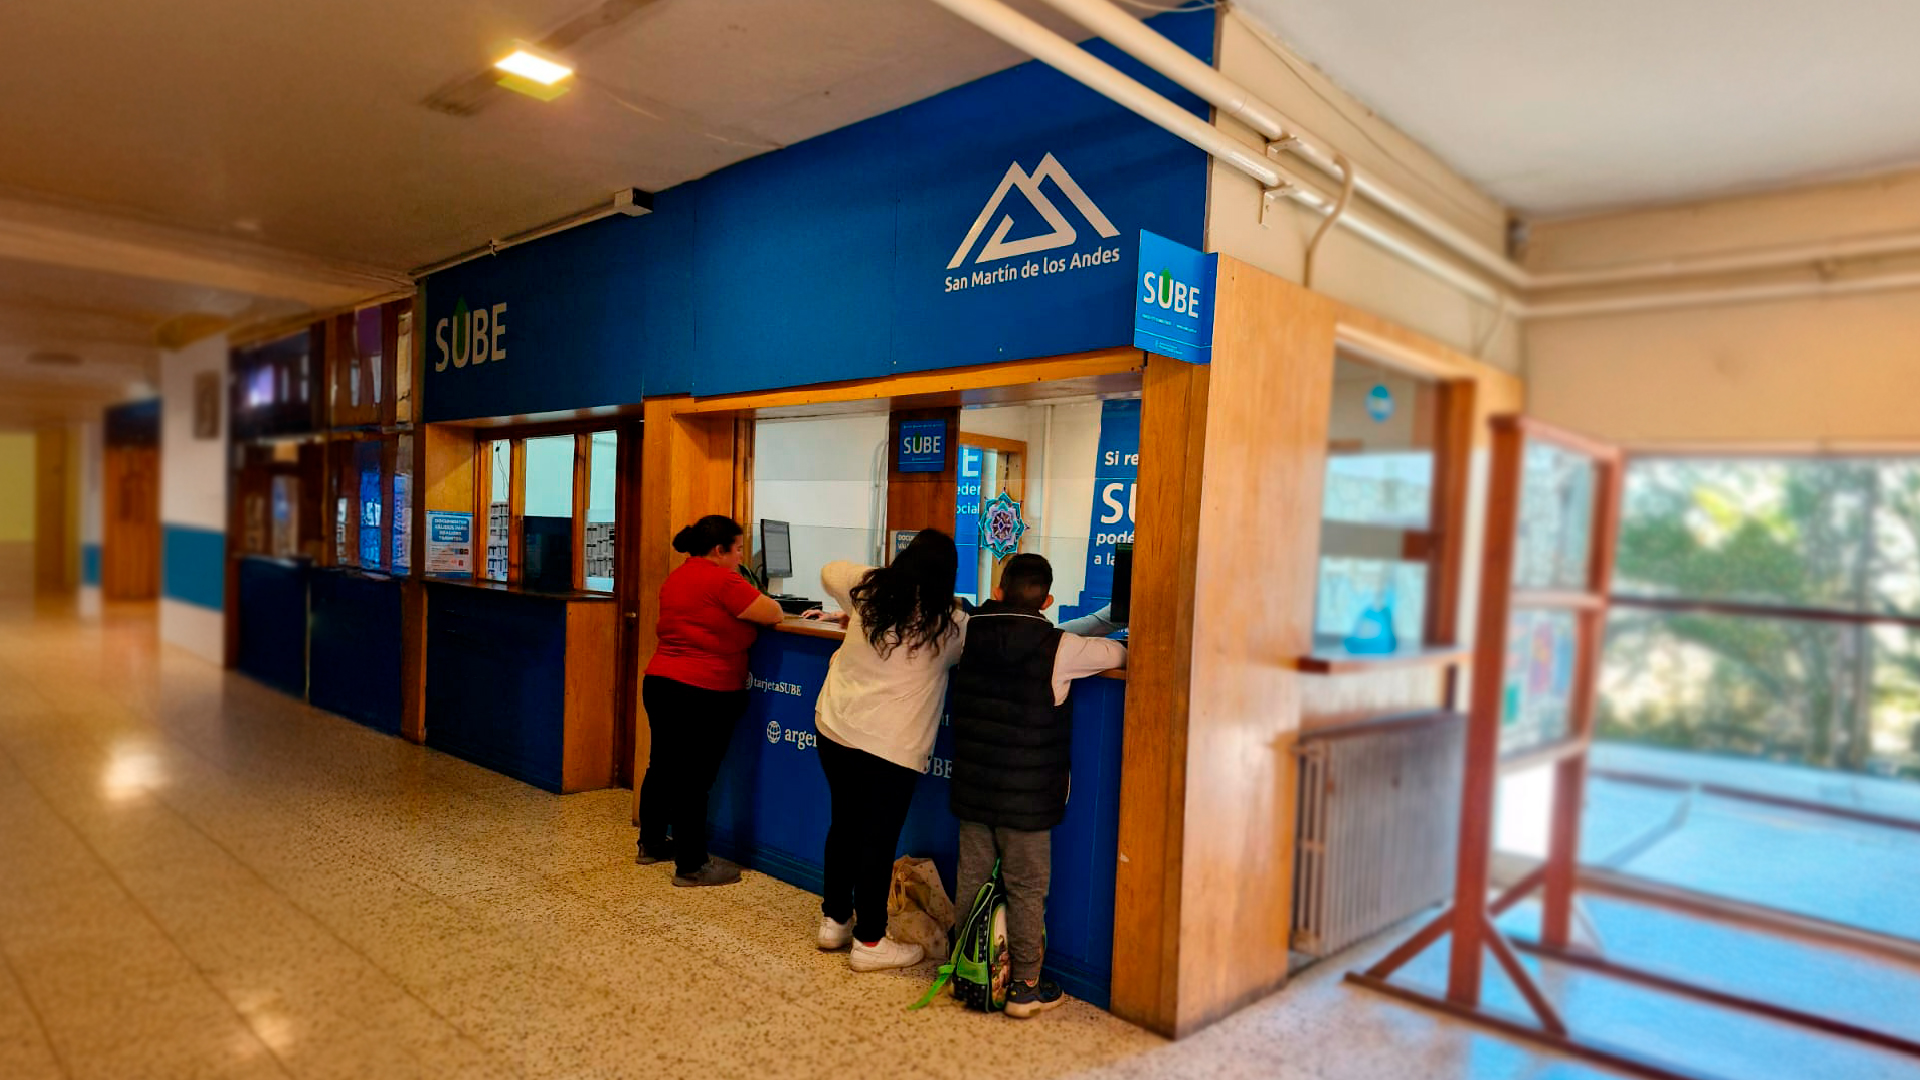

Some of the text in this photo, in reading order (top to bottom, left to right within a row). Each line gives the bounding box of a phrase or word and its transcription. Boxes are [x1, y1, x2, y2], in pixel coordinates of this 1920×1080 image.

[945, 246, 1120, 293] San Martín de los Andes
[1143, 271, 1200, 318] SUBE
[435, 301, 508, 372] SUBE
[903, 435, 942, 455] SUBE
[1104, 450, 1120, 466] Si
[1094, 554, 1102, 565] a
[753, 677, 802, 697] tarjetaSUBE
